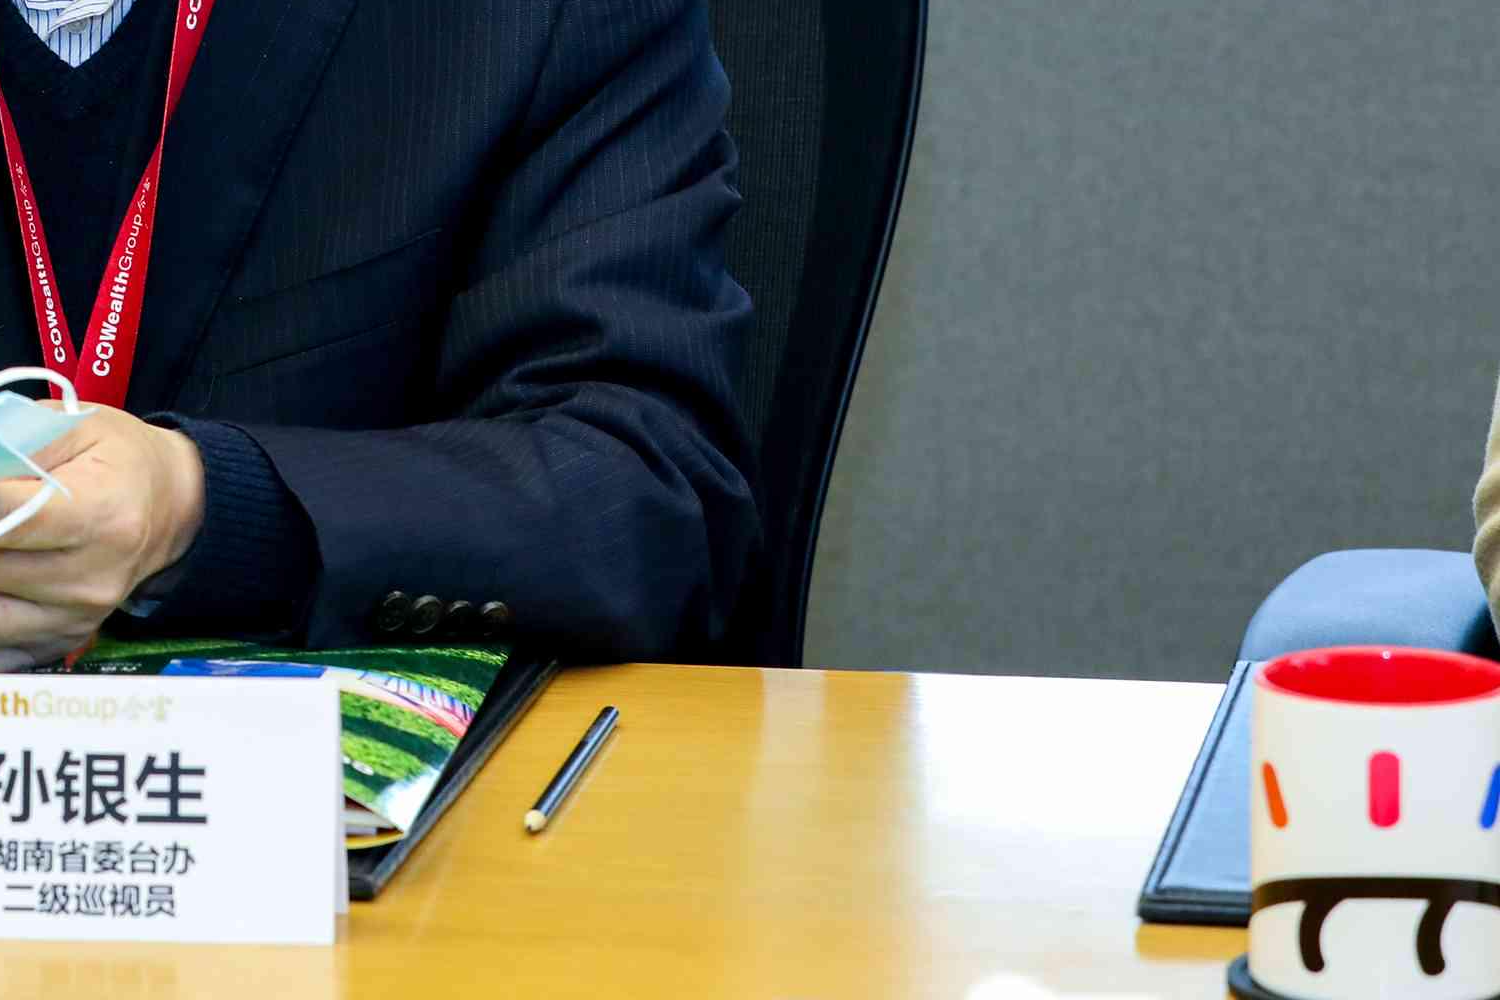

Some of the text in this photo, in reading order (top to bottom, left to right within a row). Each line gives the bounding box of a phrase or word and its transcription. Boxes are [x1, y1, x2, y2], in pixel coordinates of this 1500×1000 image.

[23, 199, 67, 364] COWealthGroup
[91, 213, 143, 377] COWealthGroup
[3, 882, 176, 917] 二级巡视员
